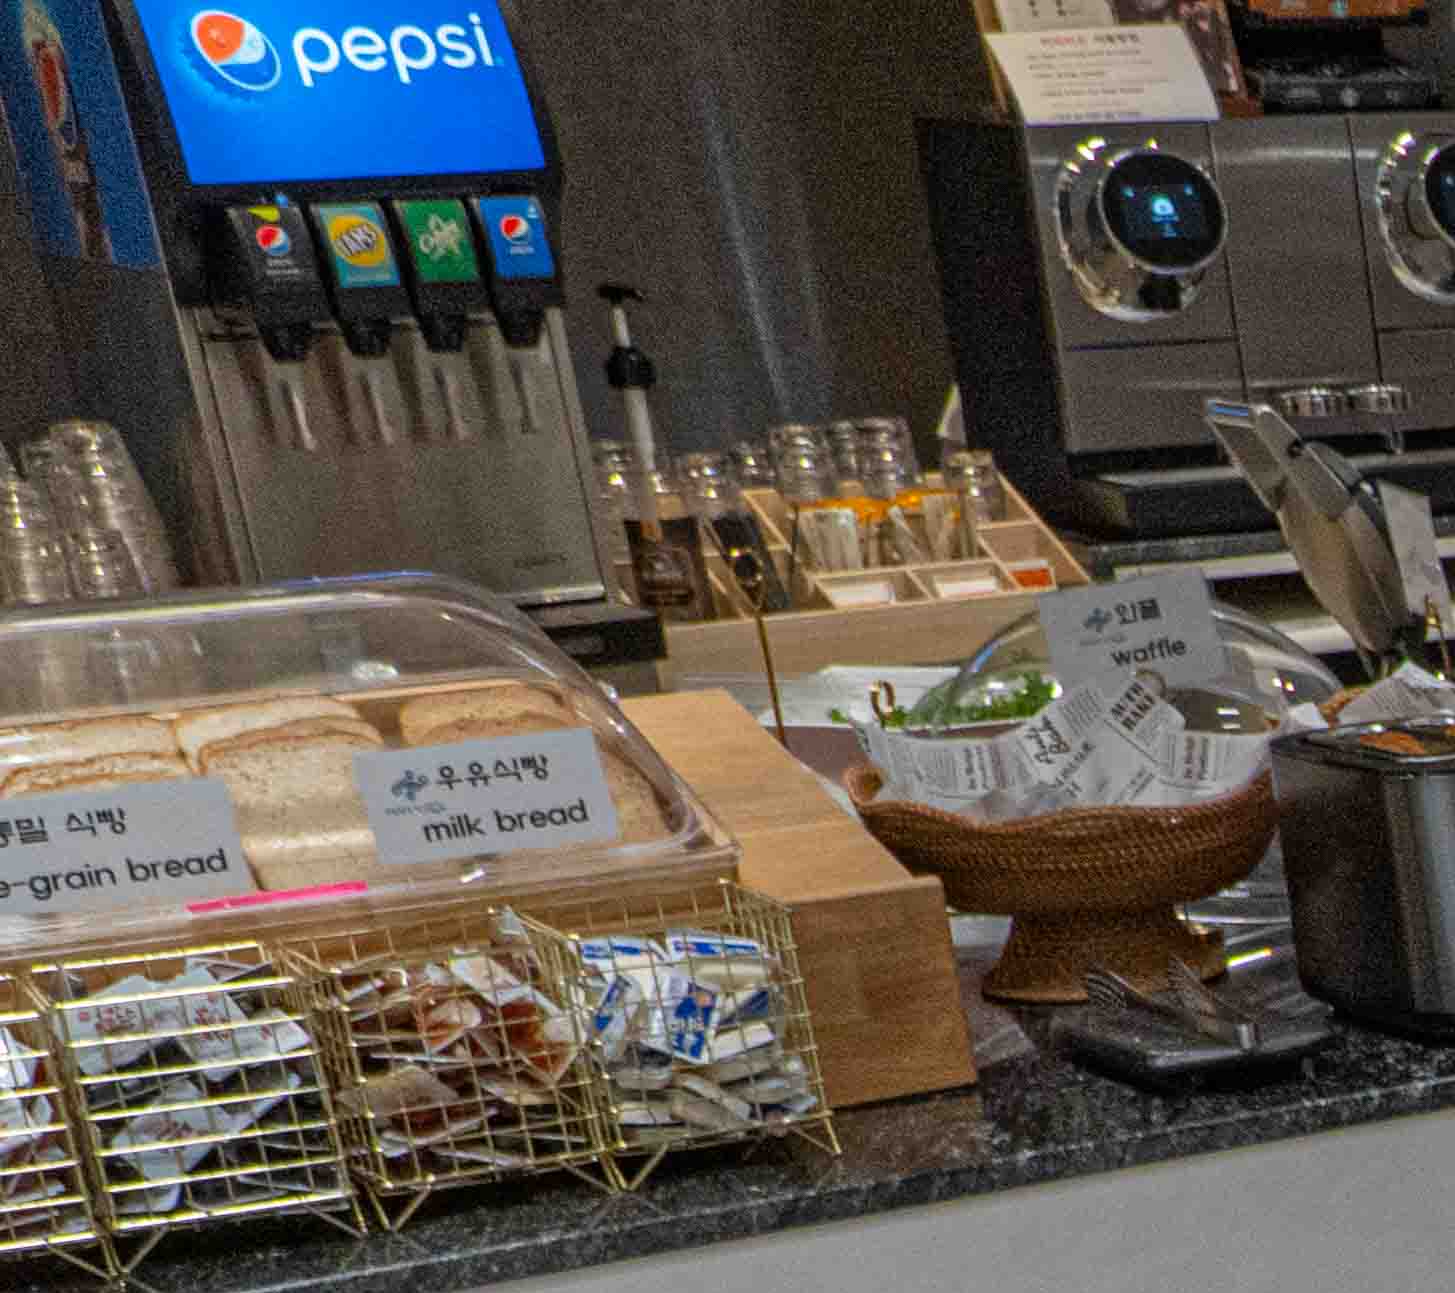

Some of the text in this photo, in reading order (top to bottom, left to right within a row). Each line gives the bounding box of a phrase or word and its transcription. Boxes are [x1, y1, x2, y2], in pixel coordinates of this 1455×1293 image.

[293, 12, 494, 88] pepsi
[1111, 637, 1187, 667] waffle
[436, 754, 549, 791] 우유식빵
[65, 807, 127, 836] 식빵
[423, 797, 590, 843] milk bread
[126, 848, 229, 883] bread
